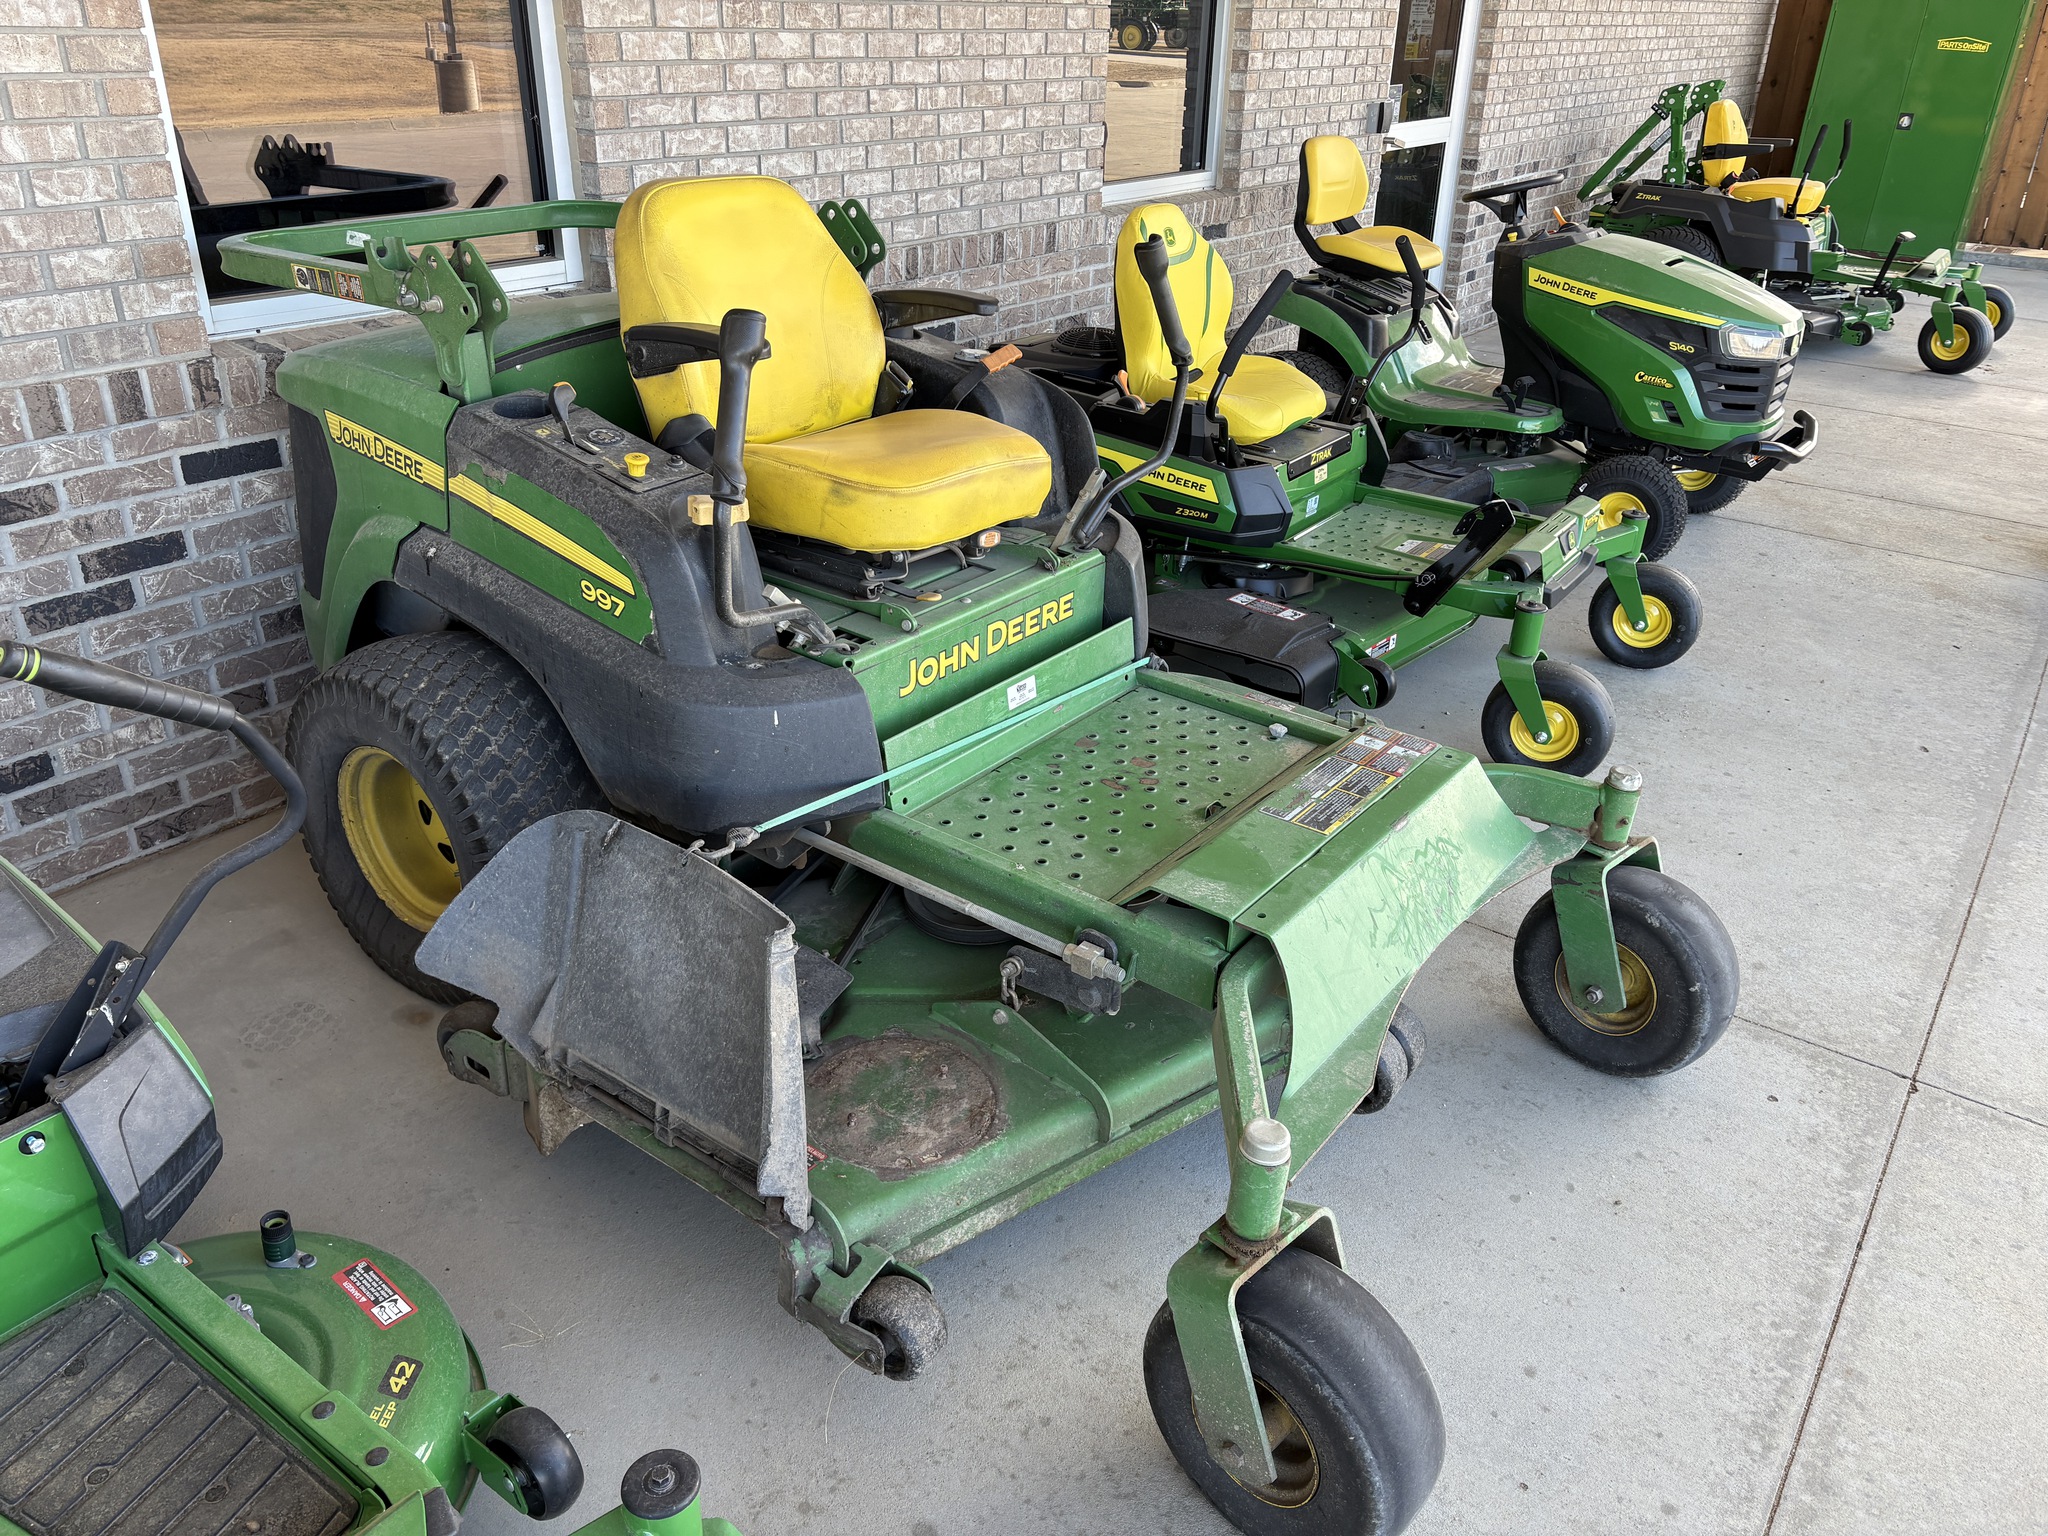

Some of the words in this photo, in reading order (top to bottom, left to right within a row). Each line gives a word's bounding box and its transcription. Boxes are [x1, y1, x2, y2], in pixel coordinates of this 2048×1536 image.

[1636, 193, 1662, 201] ZTRAK
[1533, 273, 1561, 289] JOHN
[1562, 282, 1598, 300] DEERE
[1668, 341, 1695, 354] S140
[1634, 371, 1667, 384] Carrico
[336, 420, 371, 456] JOHN
[373, 436, 424, 482] DEERE
[1310, 446, 1333, 466] ZTRAK
[1148, 470, 1165, 482] HN
[1167, 472, 1207, 492] DEERE
[1175, 507, 1209, 519] Z320M
[580, 579, 626, 618] 997
[899, 634, 980, 698] JOHN
[986, 591, 1074, 656] DEERE
[342, 1280, 362, 1299] DANGER
[389, 1361, 416, 1393] 42
[370, 1404, 385, 1422] EL
[379, 1402, 396, 1428] EEP
